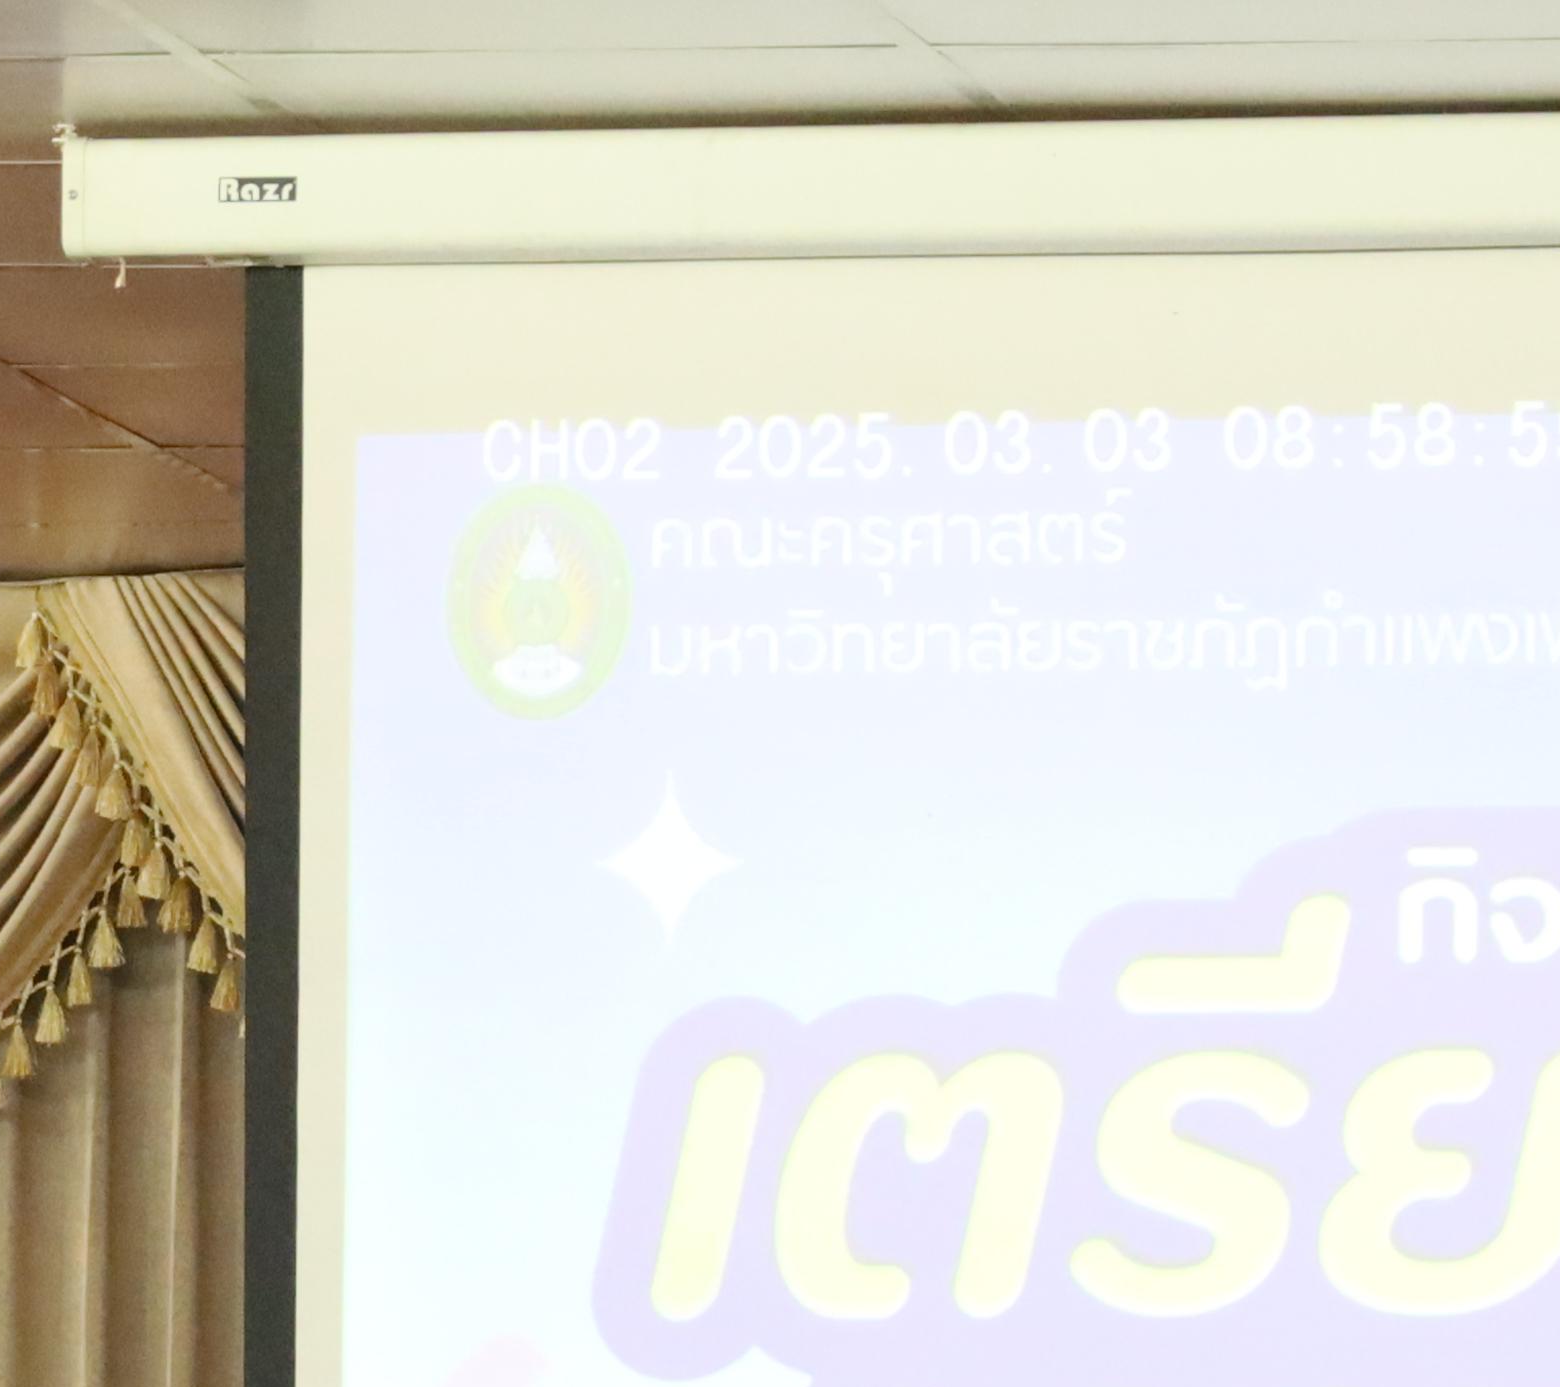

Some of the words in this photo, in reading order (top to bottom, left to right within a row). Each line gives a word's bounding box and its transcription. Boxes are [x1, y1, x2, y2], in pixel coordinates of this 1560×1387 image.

[218, 176, 297, 202] Razr
[650, 487, 1133, 597] คณะครุศาสตร์
